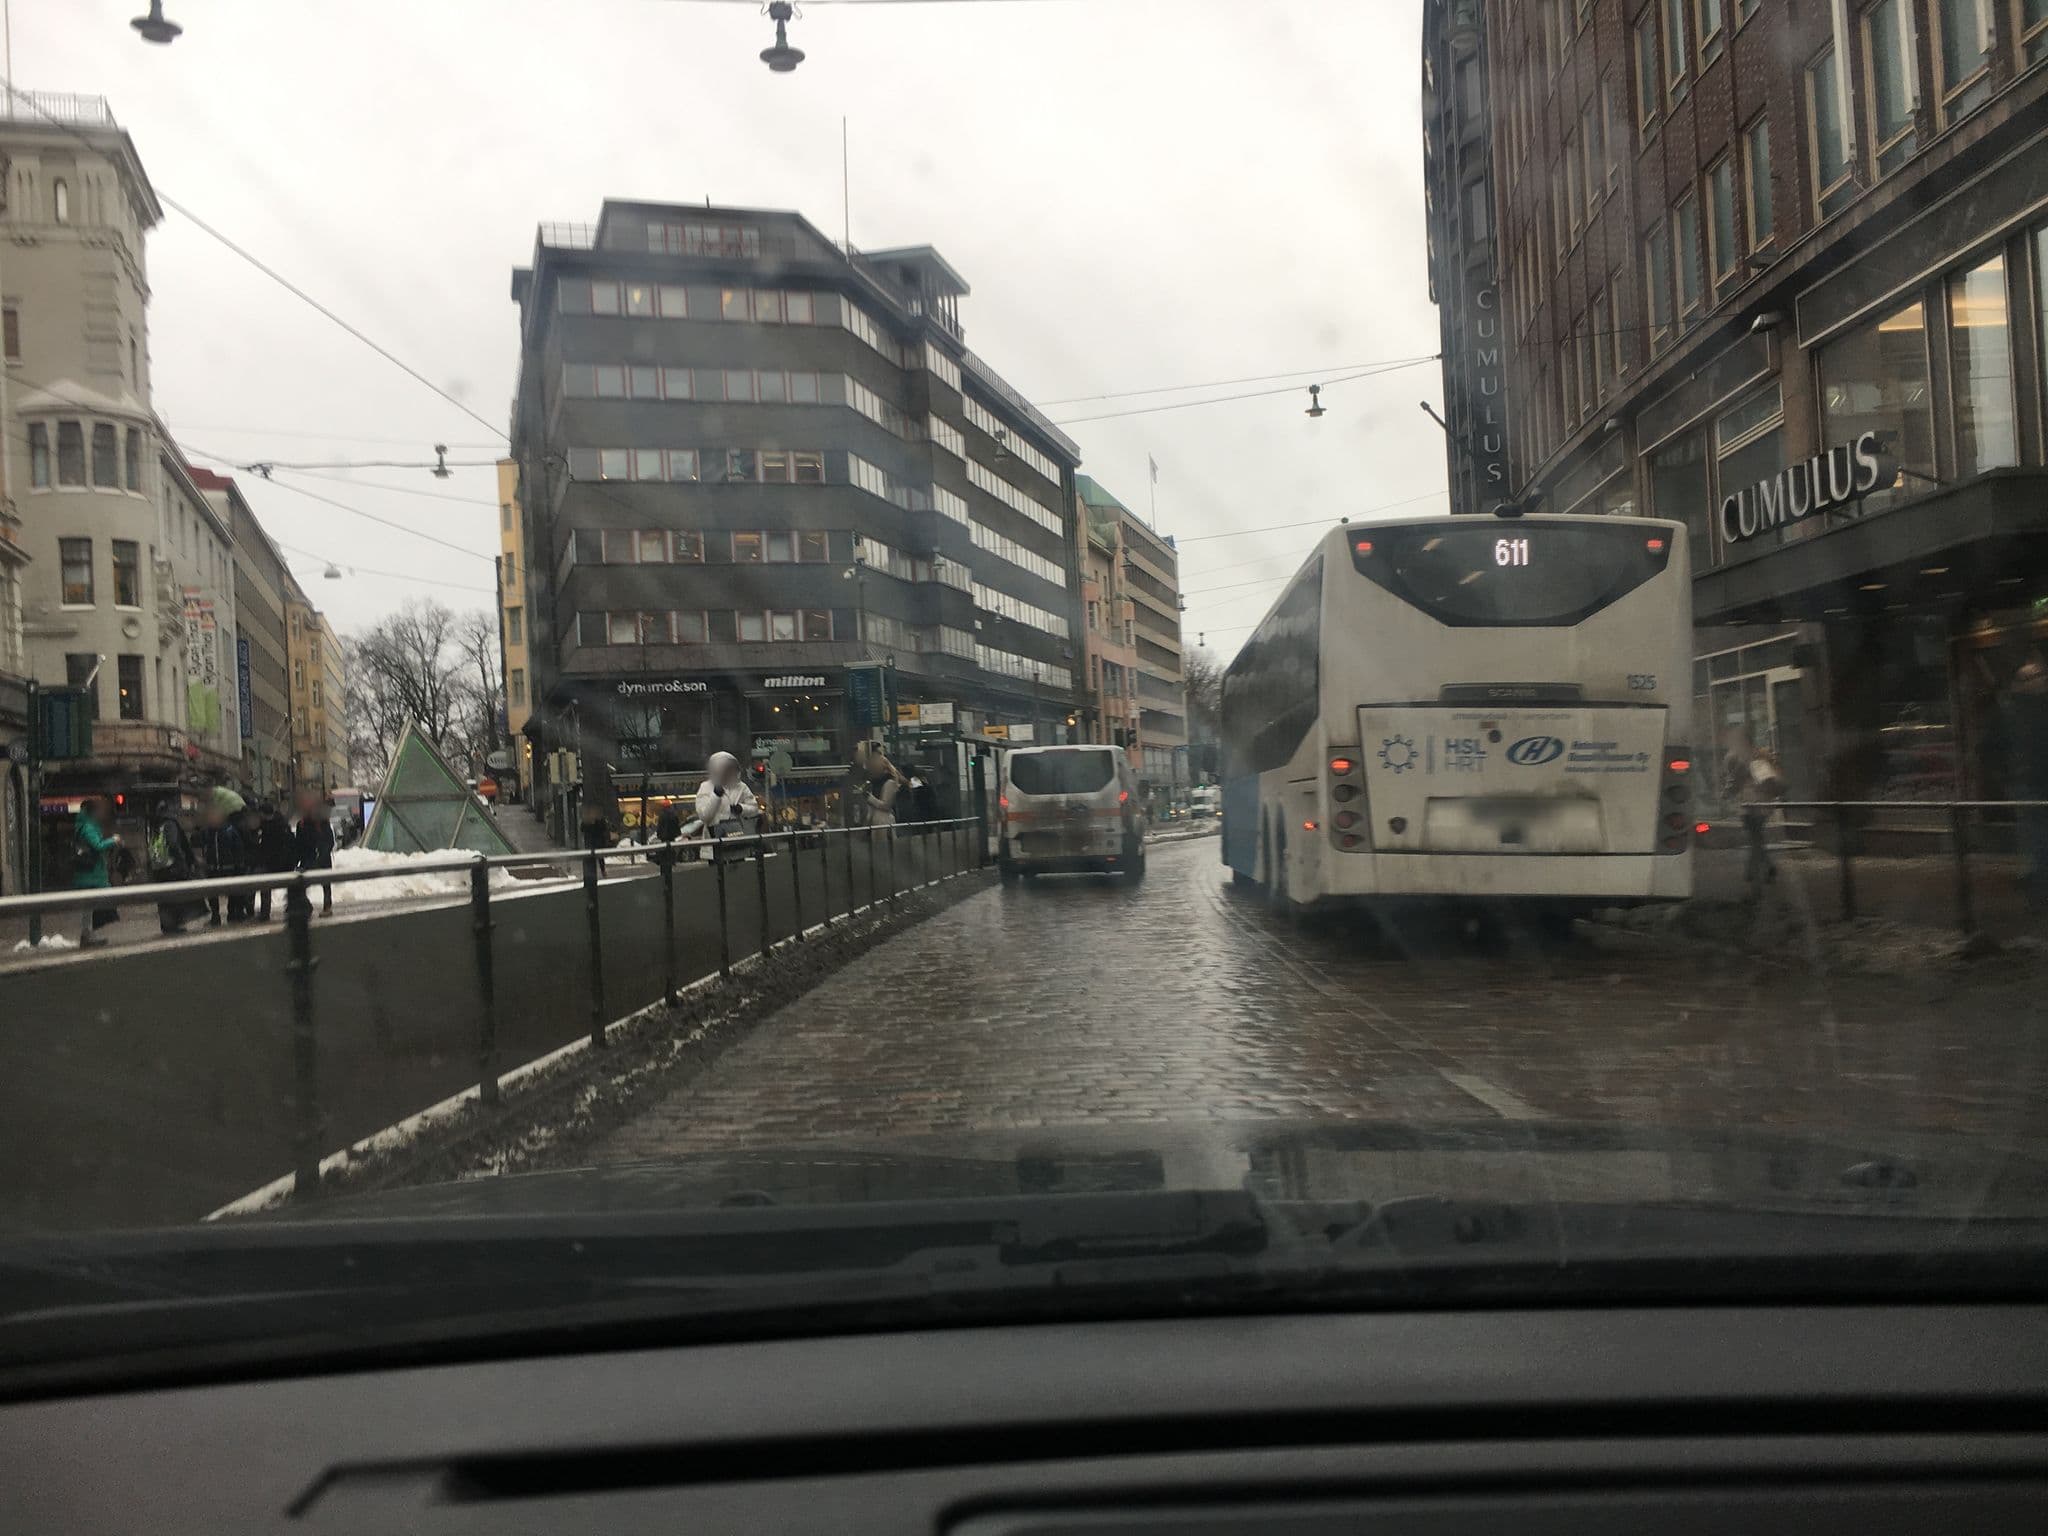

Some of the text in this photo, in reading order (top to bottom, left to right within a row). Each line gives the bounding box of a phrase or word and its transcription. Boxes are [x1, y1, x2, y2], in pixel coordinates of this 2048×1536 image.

[1476, 289, 1502, 483] CUMULUS
[1719, 430, 1879, 544] CUMULUS
[1495, 538, 1529, 567] 611
[1444, 738, 1486, 755] HSL
